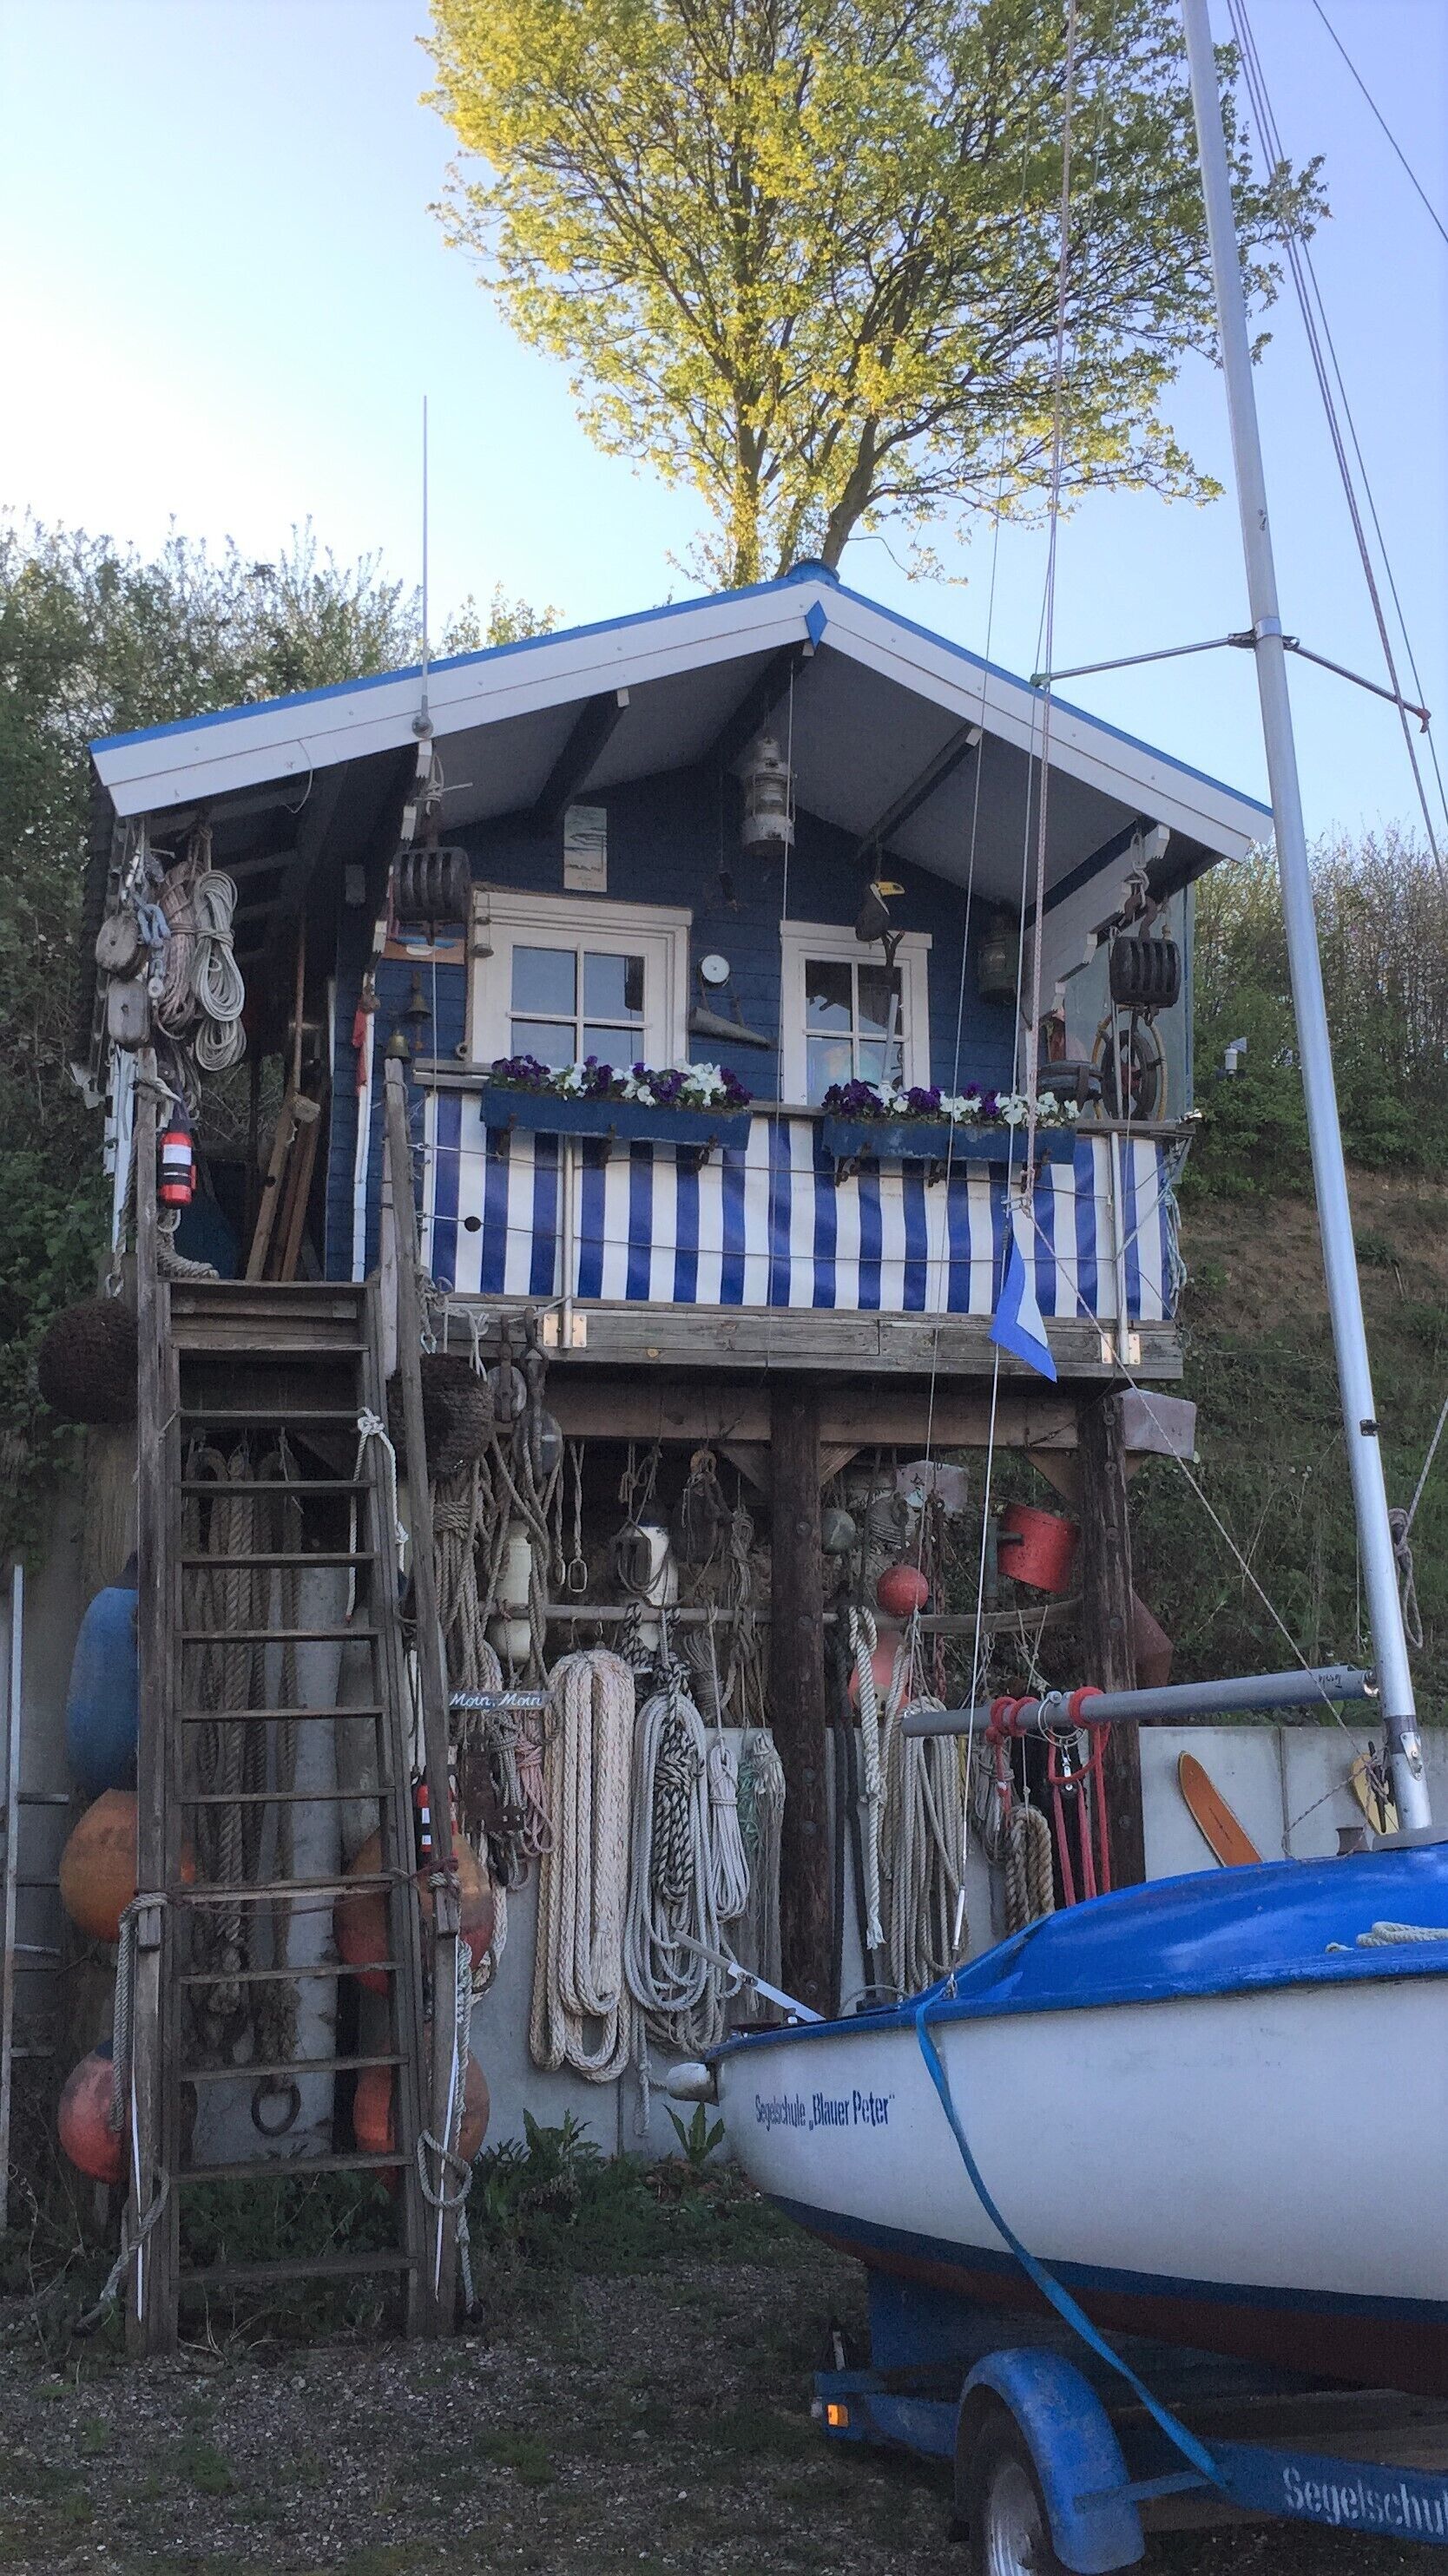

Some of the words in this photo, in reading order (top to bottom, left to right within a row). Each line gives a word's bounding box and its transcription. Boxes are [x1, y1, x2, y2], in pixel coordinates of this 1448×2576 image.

[449, 1692, 496, 1706] Moin,
[498, 1692, 542, 1706] Moin
[755, 2093, 806, 2132] Segelschule
